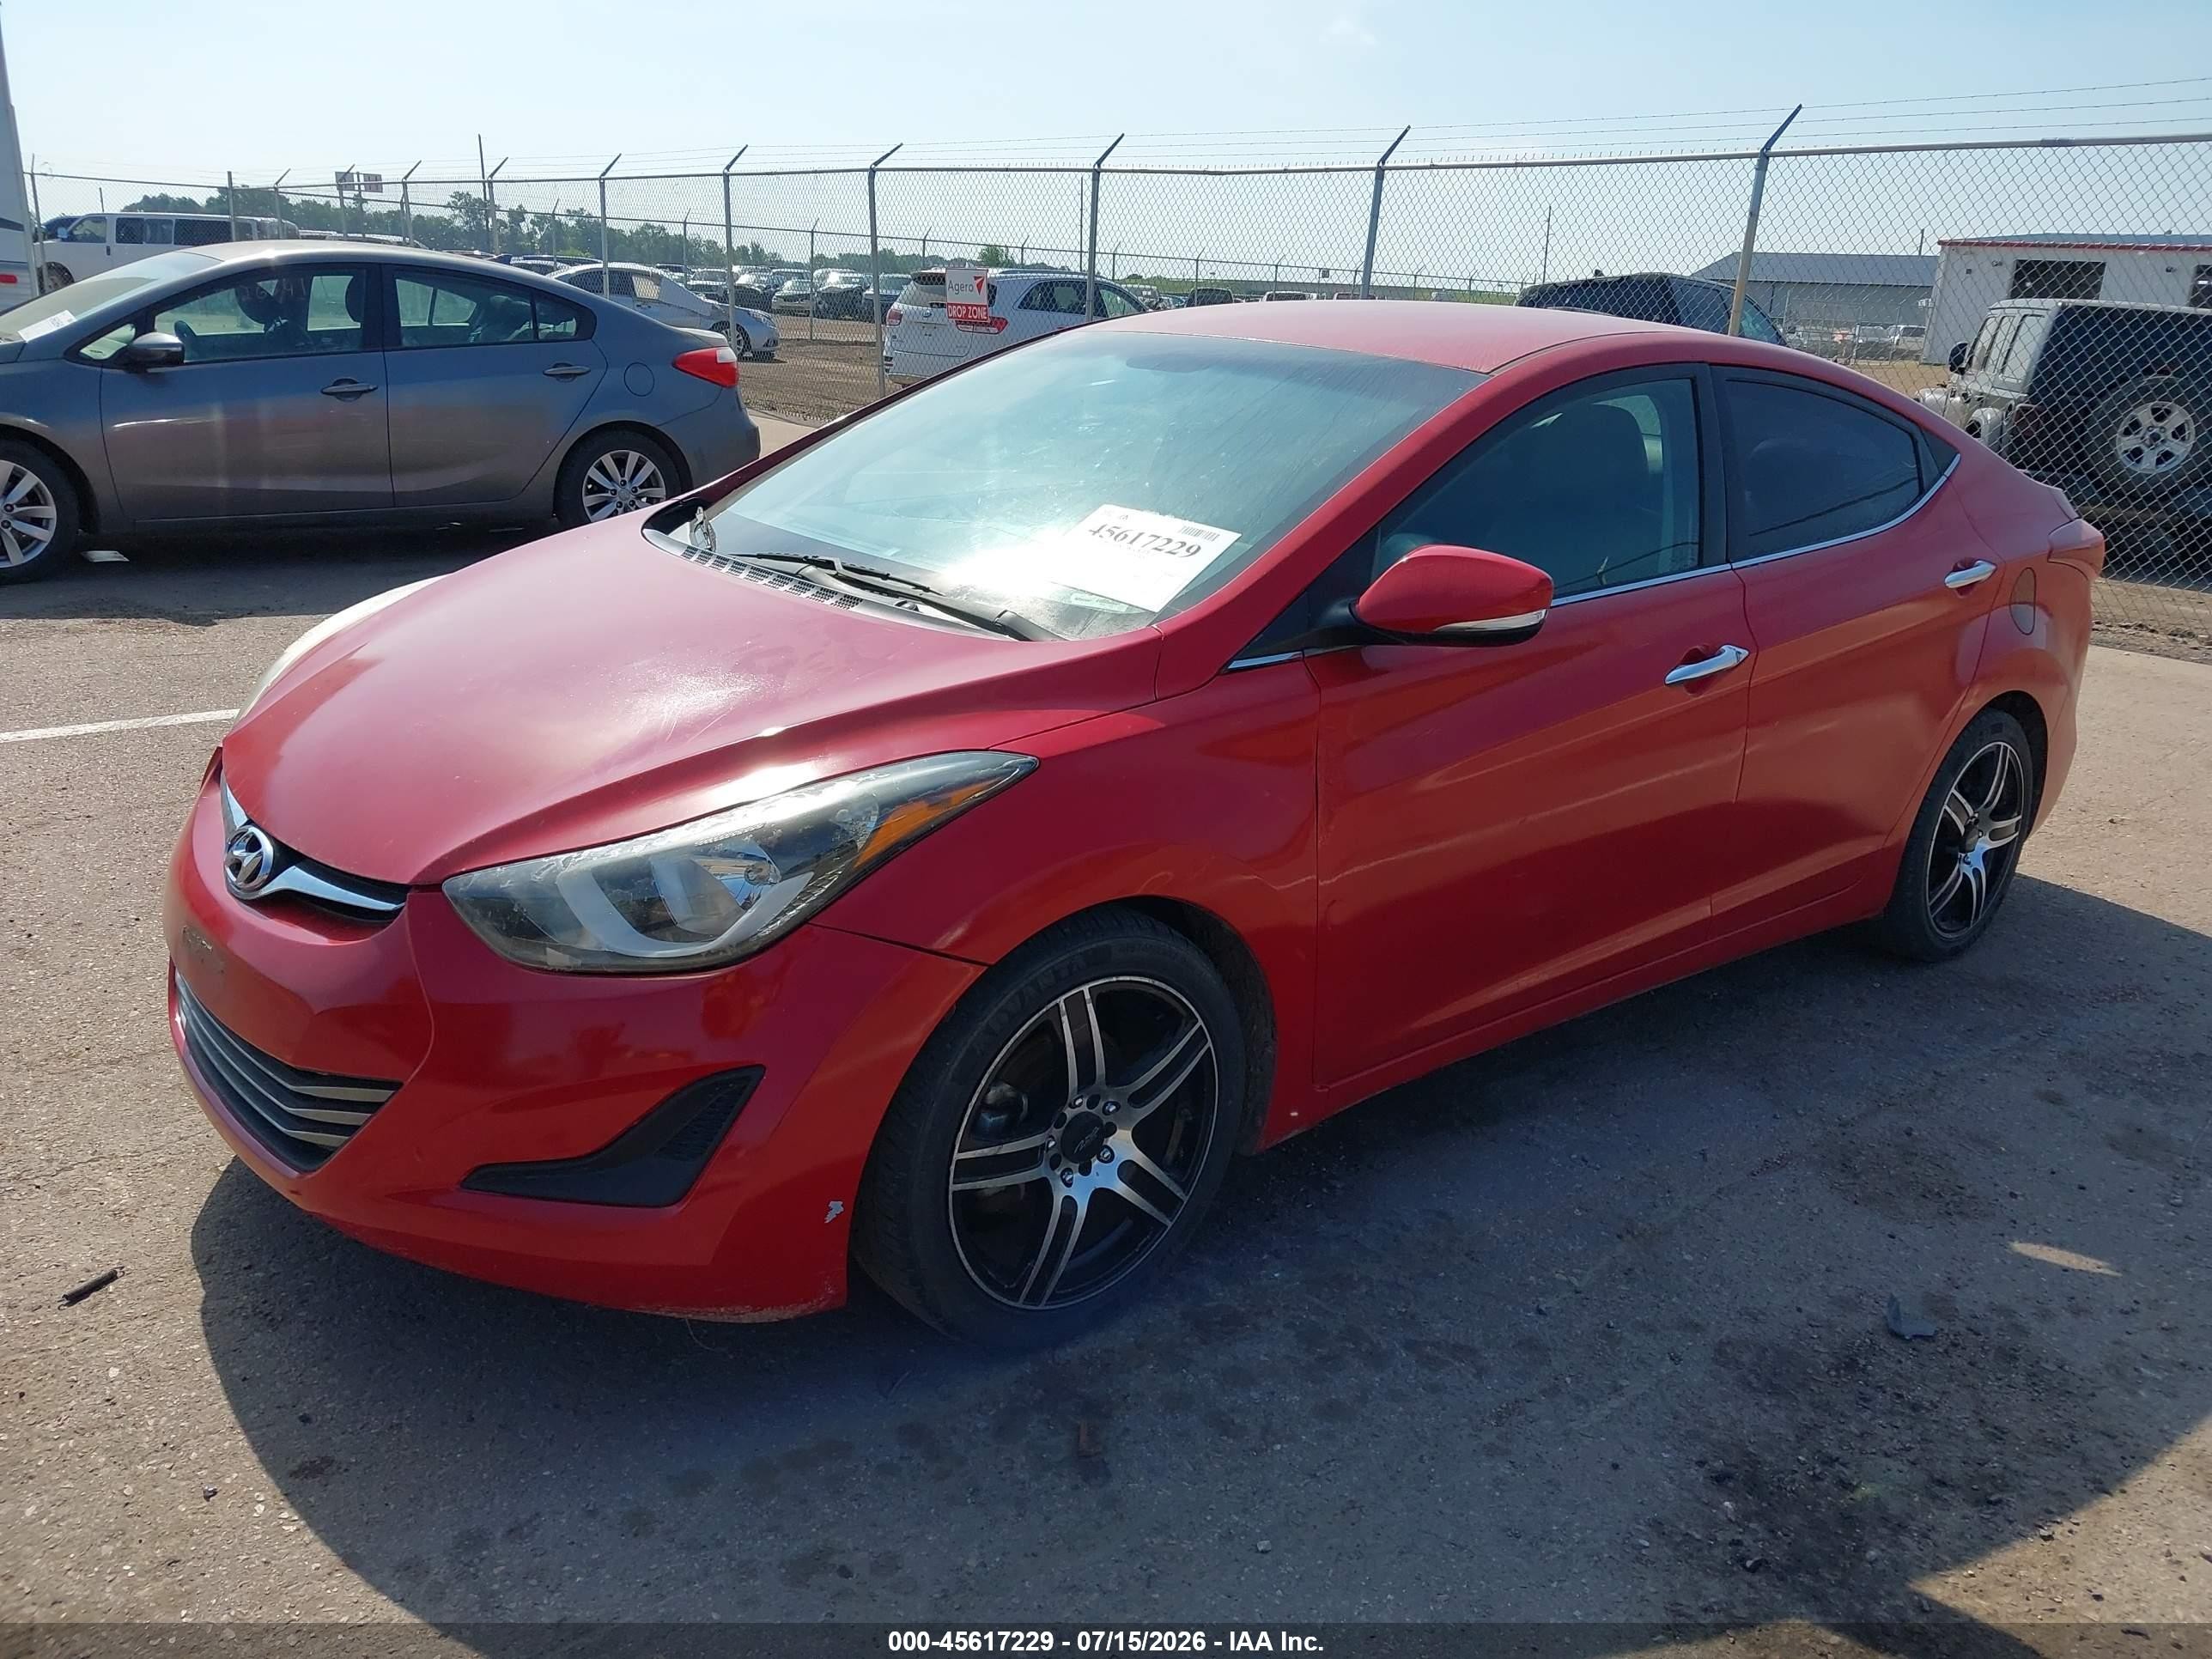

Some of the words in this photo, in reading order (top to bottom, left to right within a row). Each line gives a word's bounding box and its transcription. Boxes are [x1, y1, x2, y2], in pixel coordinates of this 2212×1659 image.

[947, 280, 974, 295] Agero
[948, 305, 967, 318] DROP
[968, 306, 988, 319] ZONE
[1088, 523, 1201, 557] 45617229
